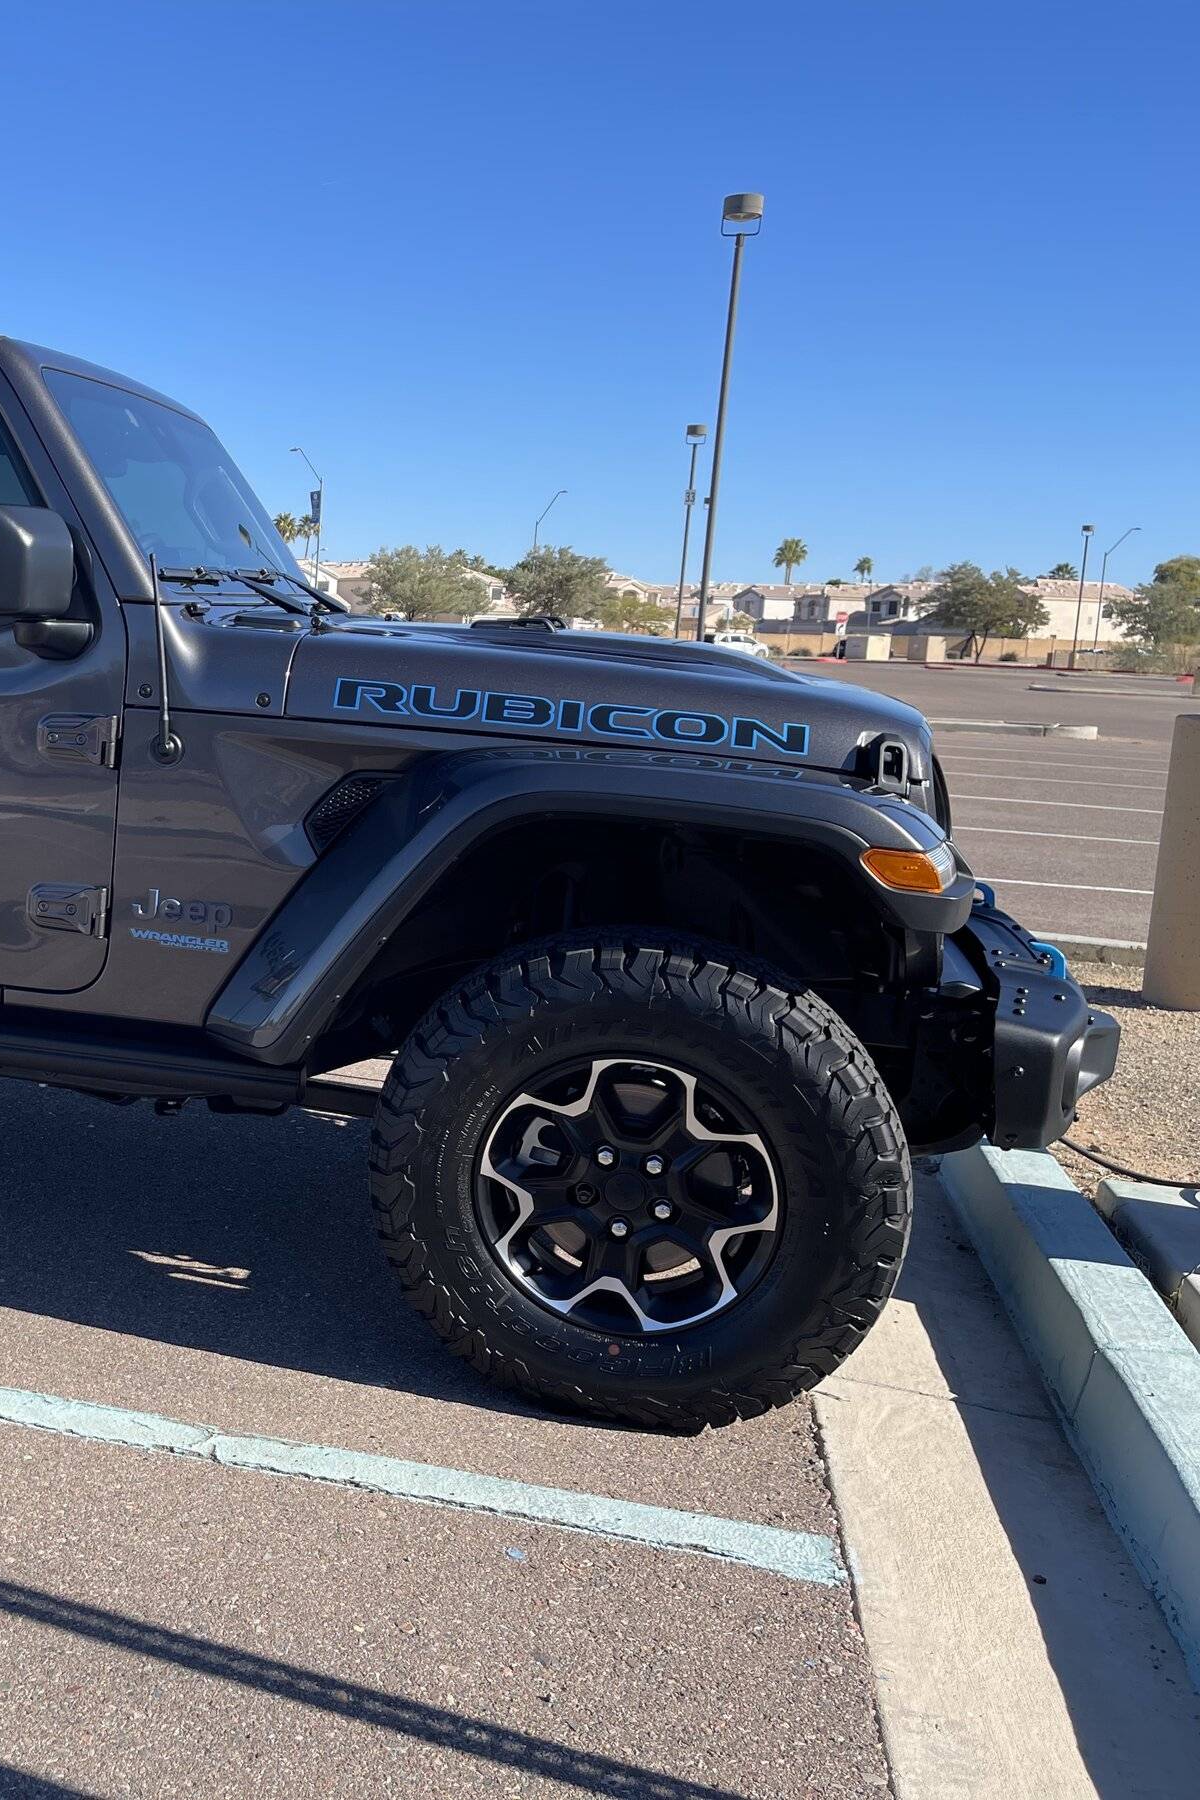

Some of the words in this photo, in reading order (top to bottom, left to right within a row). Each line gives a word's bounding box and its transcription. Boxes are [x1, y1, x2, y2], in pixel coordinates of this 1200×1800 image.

[332, 677, 811, 756] RUBICON
[131, 888, 233, 934] Jeep
[129, 928, 229, 949] WRANGLER
[160, 940, 229, 953] UNLIMITED
